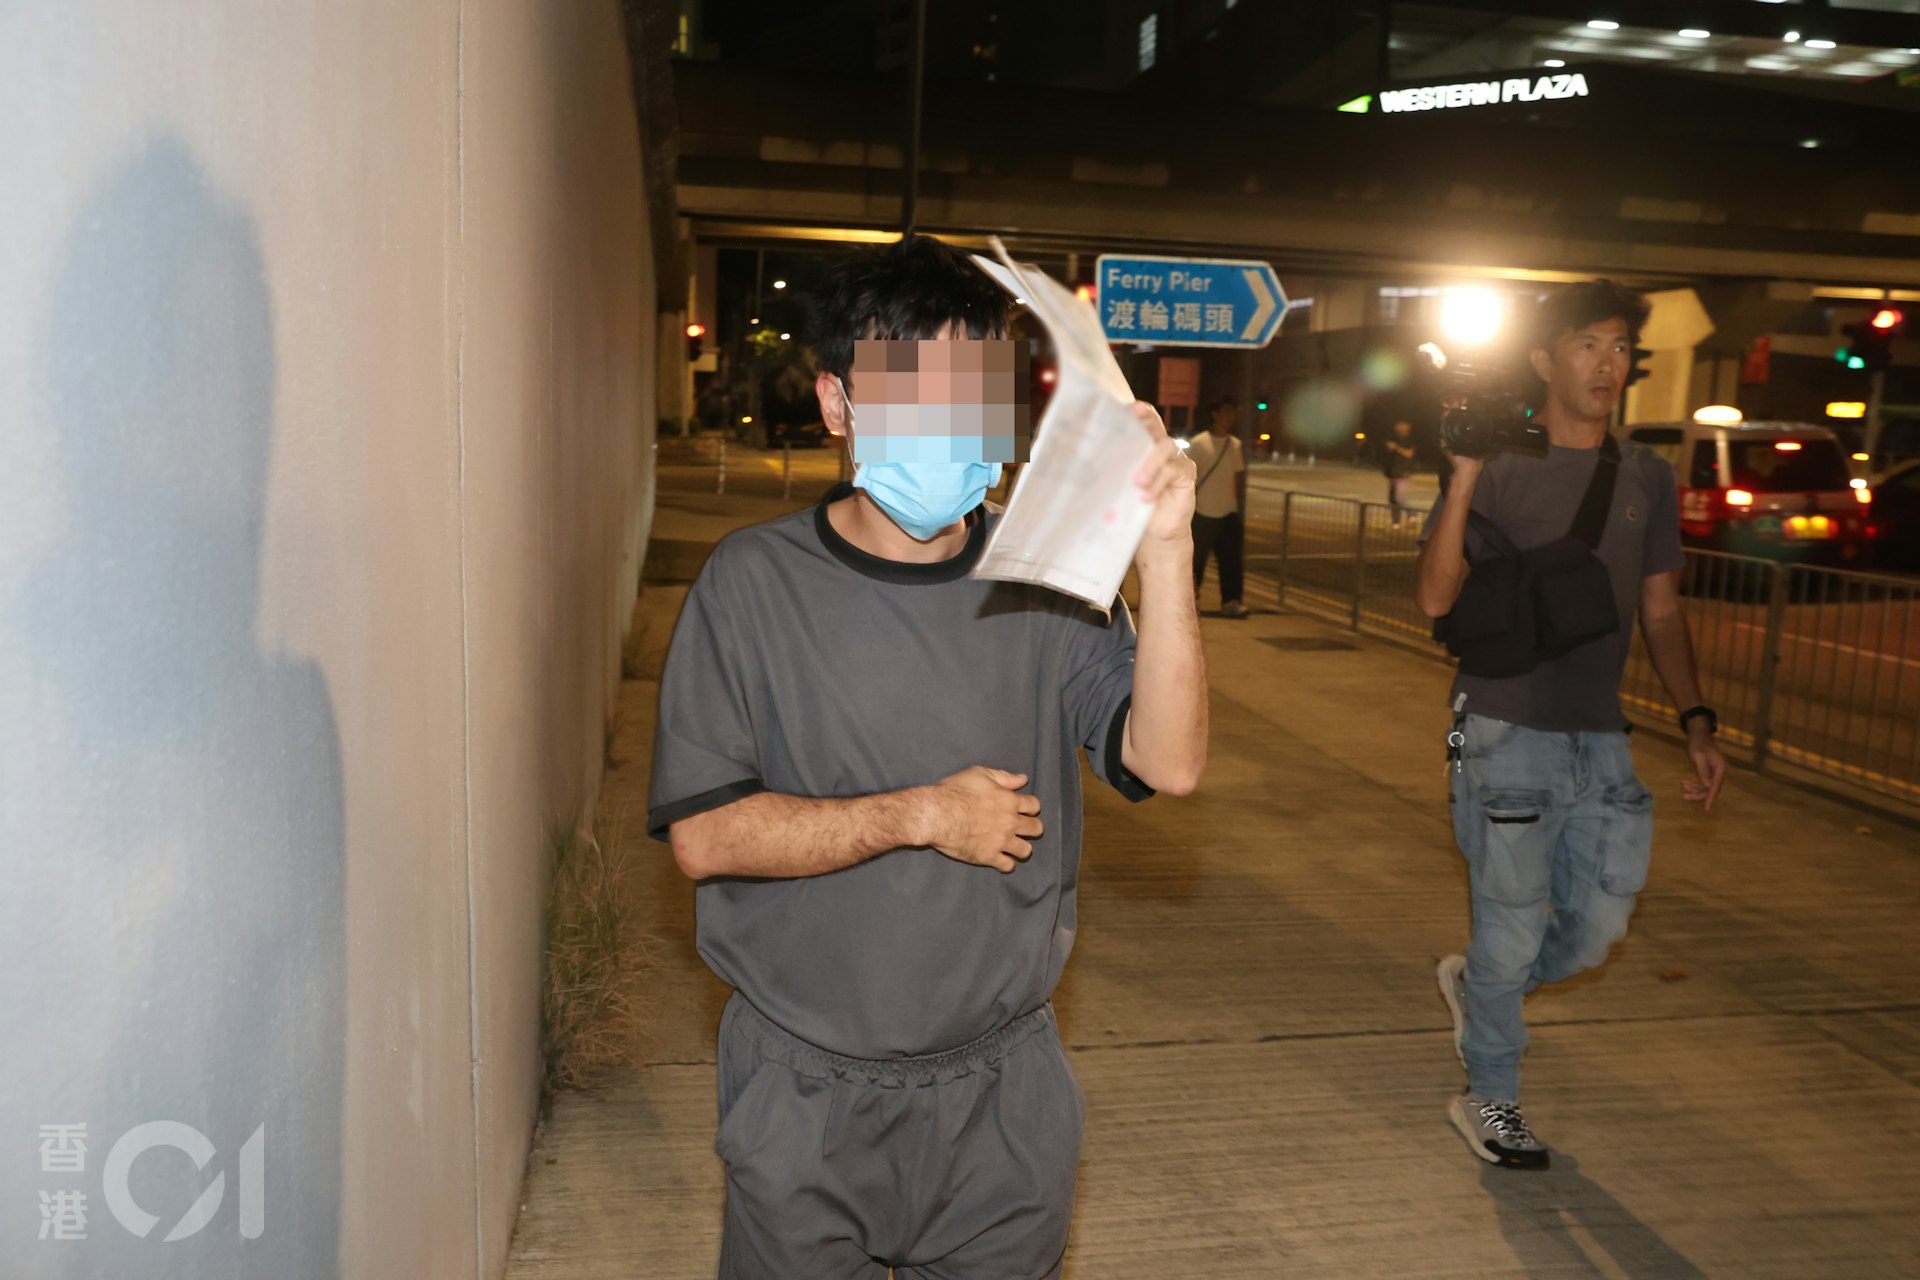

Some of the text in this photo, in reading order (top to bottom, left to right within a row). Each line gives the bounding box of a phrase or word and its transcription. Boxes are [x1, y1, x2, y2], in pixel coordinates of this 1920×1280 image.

[1379, 73, 1589, 113] WESTERN PLAZA
[1107, 268, 1212, 294] Ferry Pier
[1107, 299, 1234, 333] 渡輪碼頭
